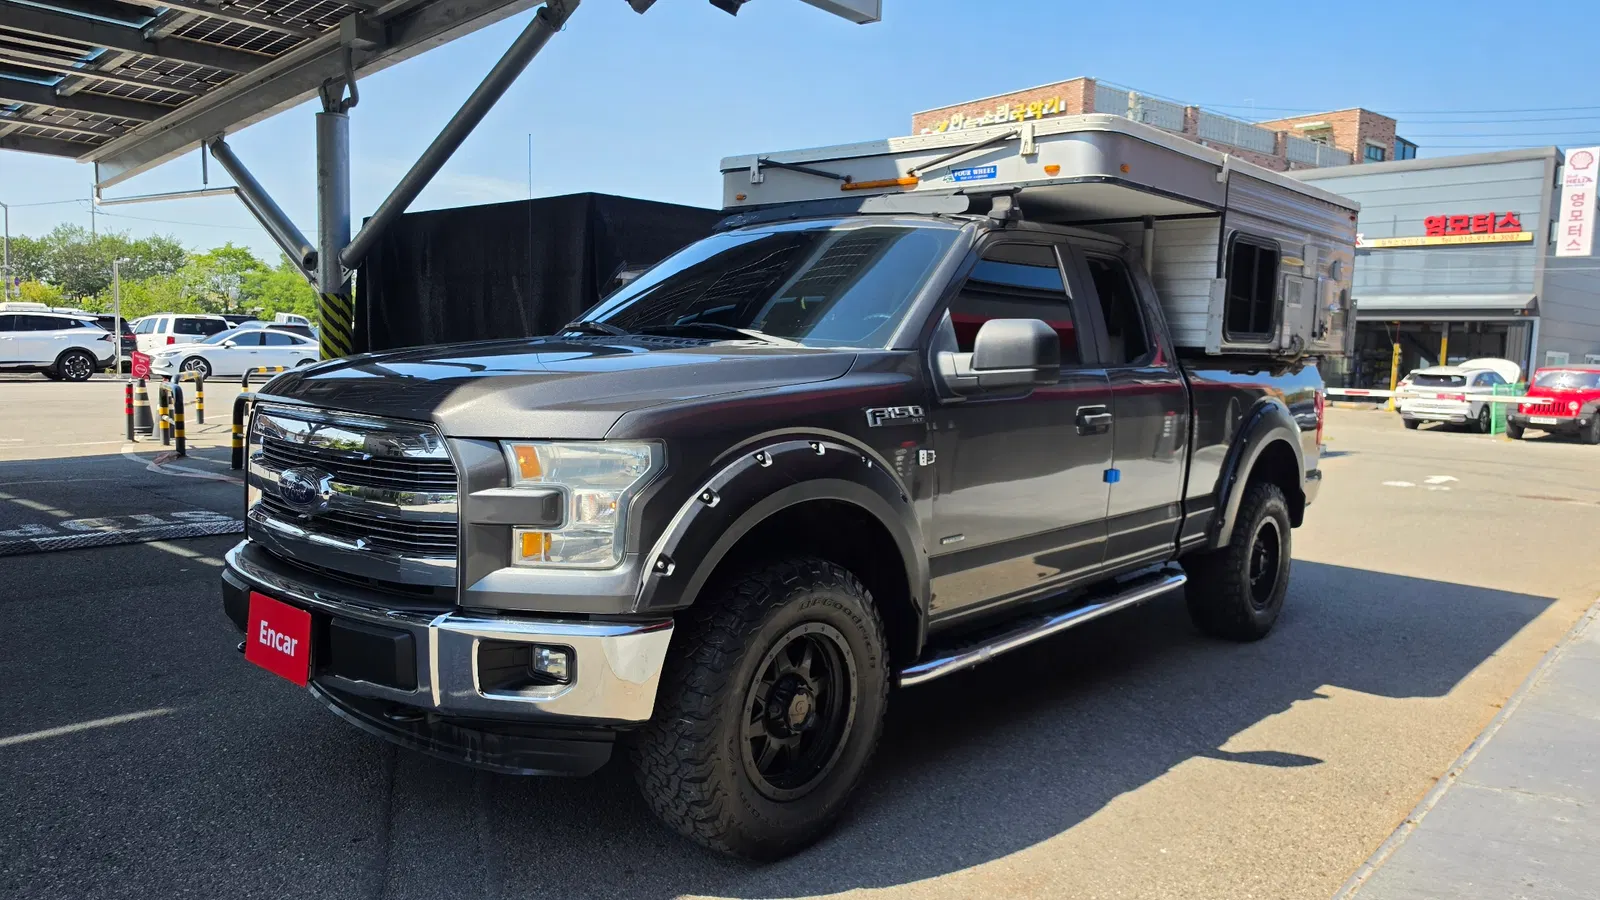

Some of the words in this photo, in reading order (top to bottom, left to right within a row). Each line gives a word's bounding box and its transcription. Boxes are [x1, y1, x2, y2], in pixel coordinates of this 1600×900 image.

[954, 169, 971, 177] FOUR
[972, 167, 995, 175] WHEEL
[1424, 211, 1522, 237] 영모터스
[1565, 192, 1585, 251] 영모터스
[259, 619, 298, 657] Encar
